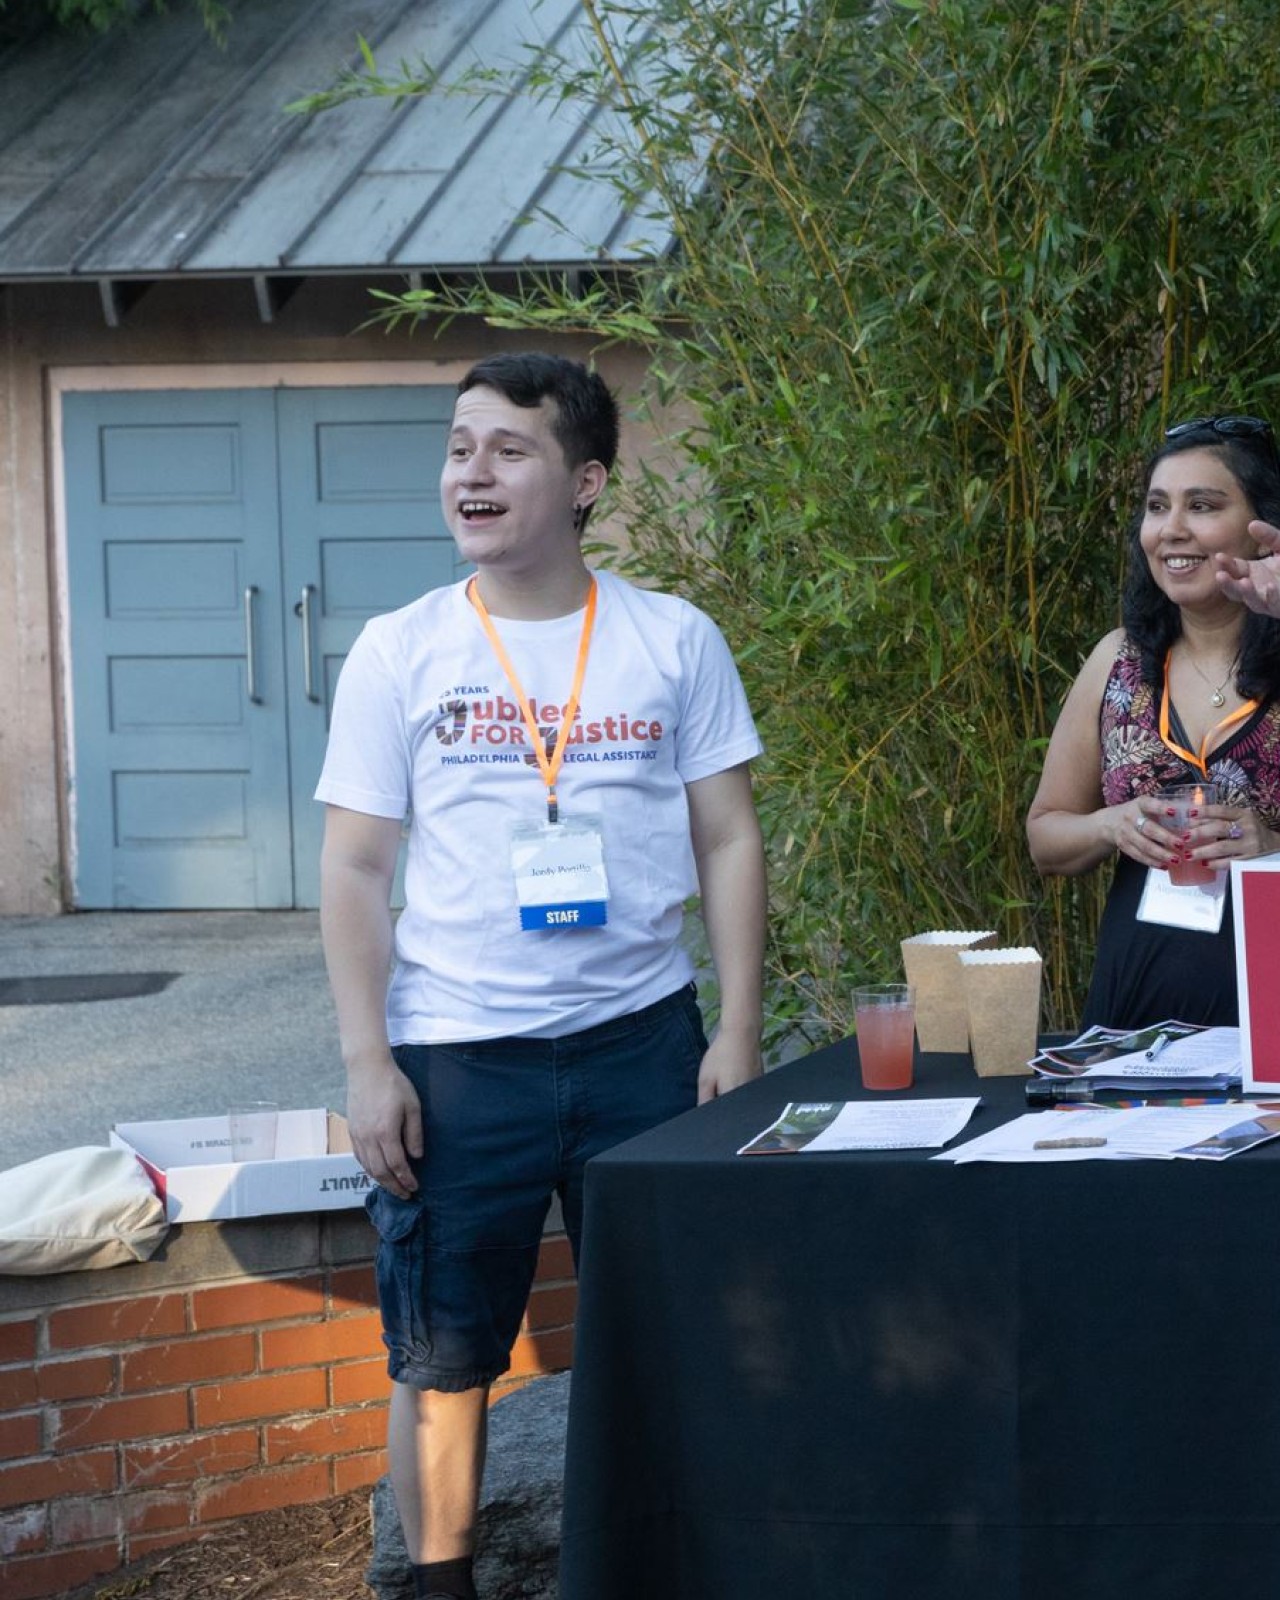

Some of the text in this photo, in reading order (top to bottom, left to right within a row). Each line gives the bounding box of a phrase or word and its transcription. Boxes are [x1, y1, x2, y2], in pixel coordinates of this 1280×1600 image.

[453, 685, 490, 696] YEARS
[471, 724, 526, 745] FOR
[440, 753, 521, 766] PHILADELPHIA
[563, 752, 600, 764] LEGAL
[545, 909, 580, 924] STAFF
